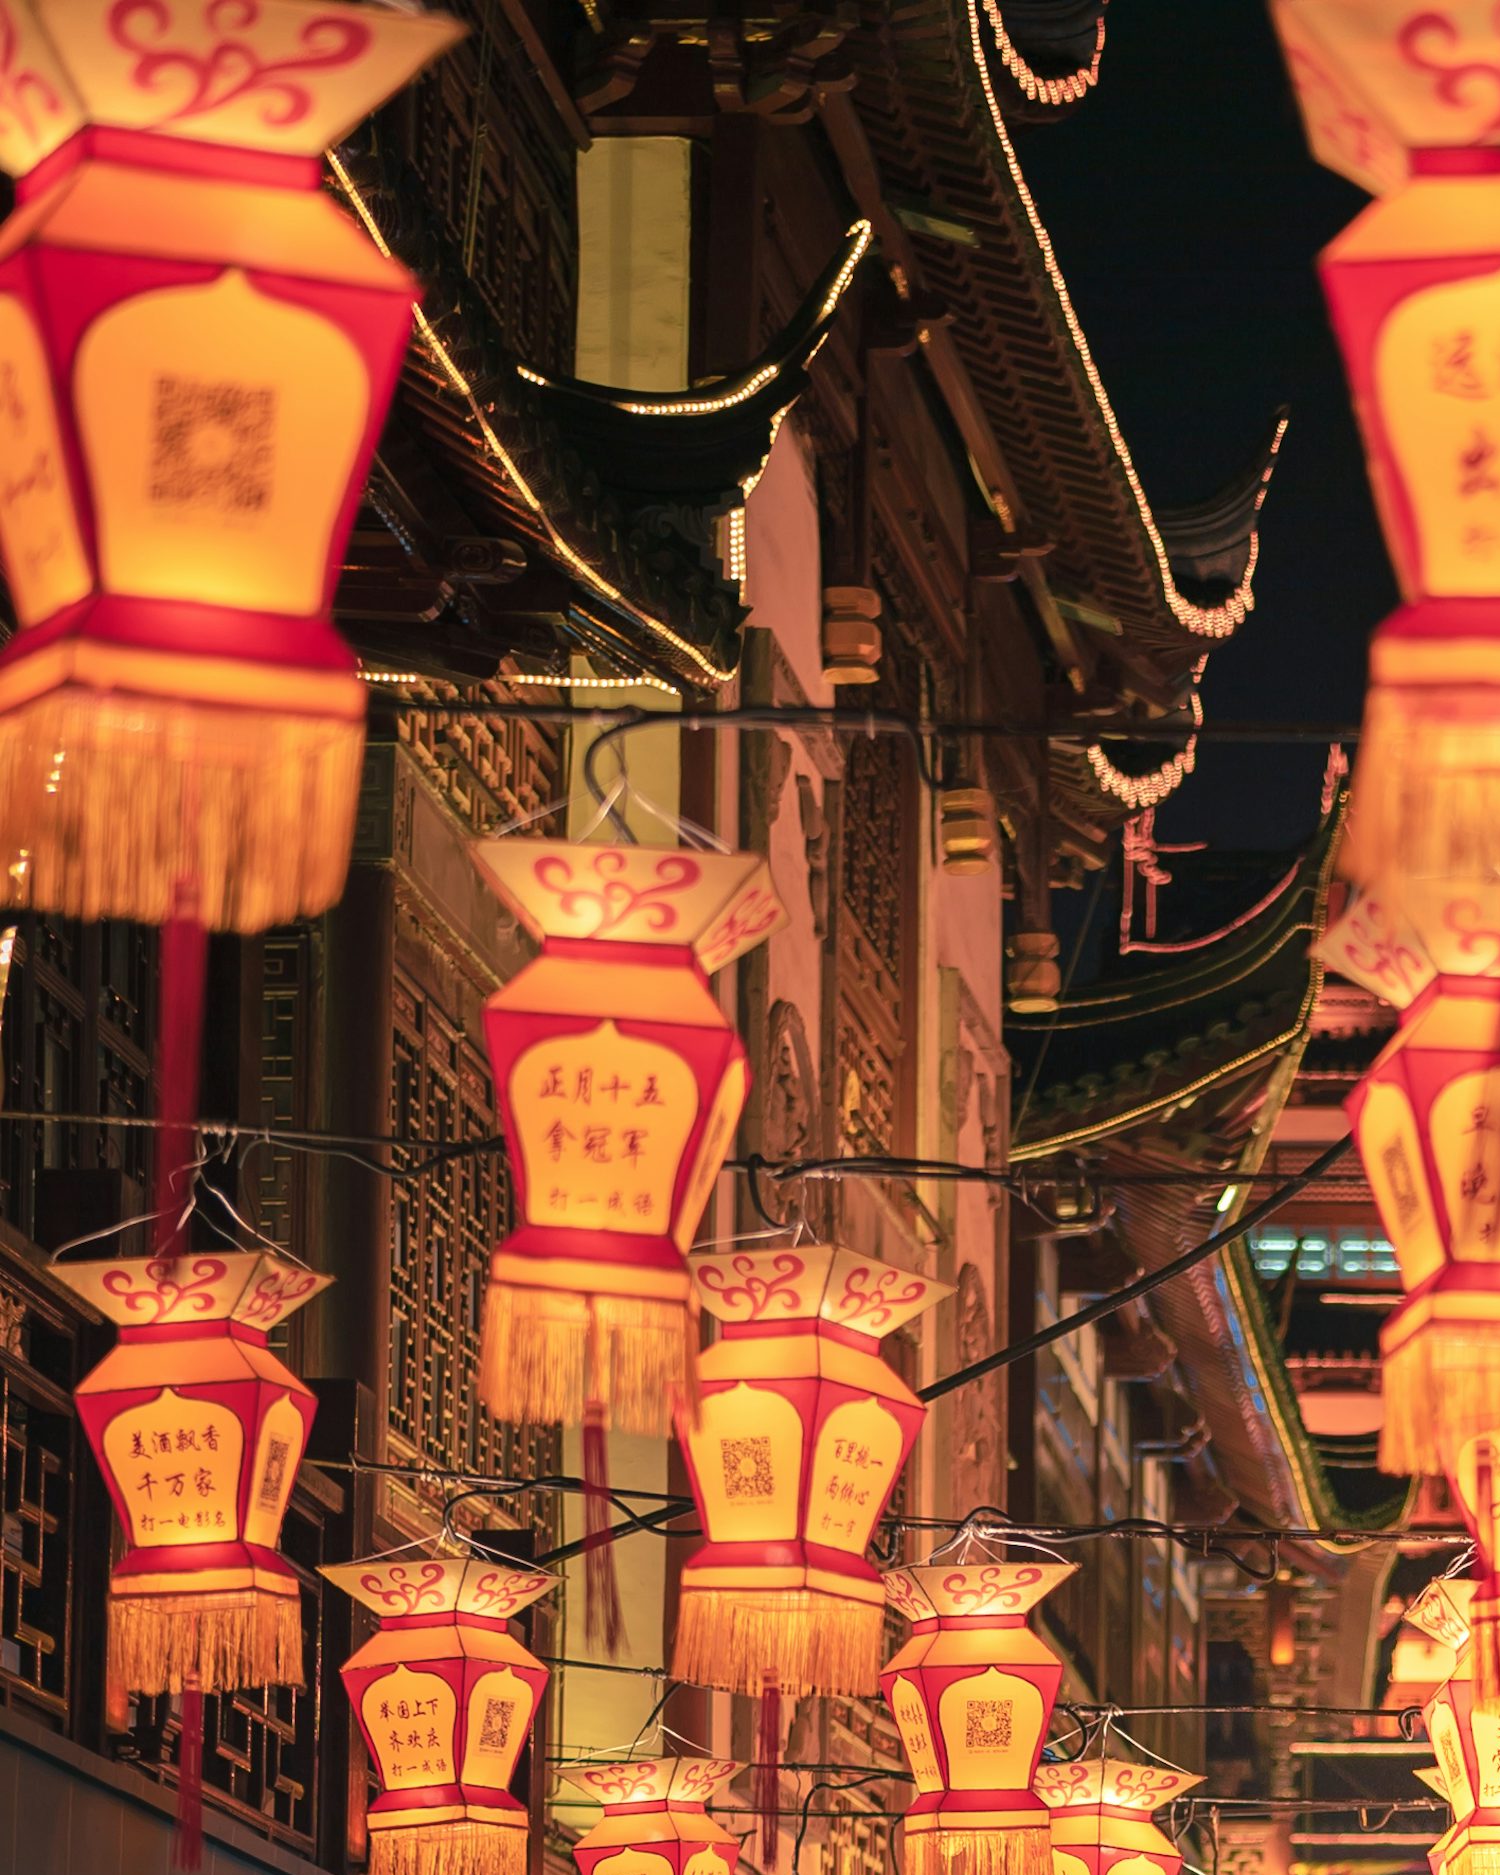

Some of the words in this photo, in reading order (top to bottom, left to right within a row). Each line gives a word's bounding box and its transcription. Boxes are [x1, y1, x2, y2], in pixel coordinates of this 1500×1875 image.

[540, 1066, 666, 1107] 正月十五
[544, 1120, 649, 1169] 拿冠军
[550, 1187, 655, 1216] 打一成语
[129, 1424, 221, 1460] 美酒飘香
[137, 1467, 217, 1502] 千万家
[140, 1511, 226, 1532] 打一电影名
[821, 1513, 856, 1537] 打一字
[379, 1698, 439, 1721] 举国上下
[388, 1728, 440, 1752] 齐欢庆
[391, 1758, 448, 1777] 打一成语
